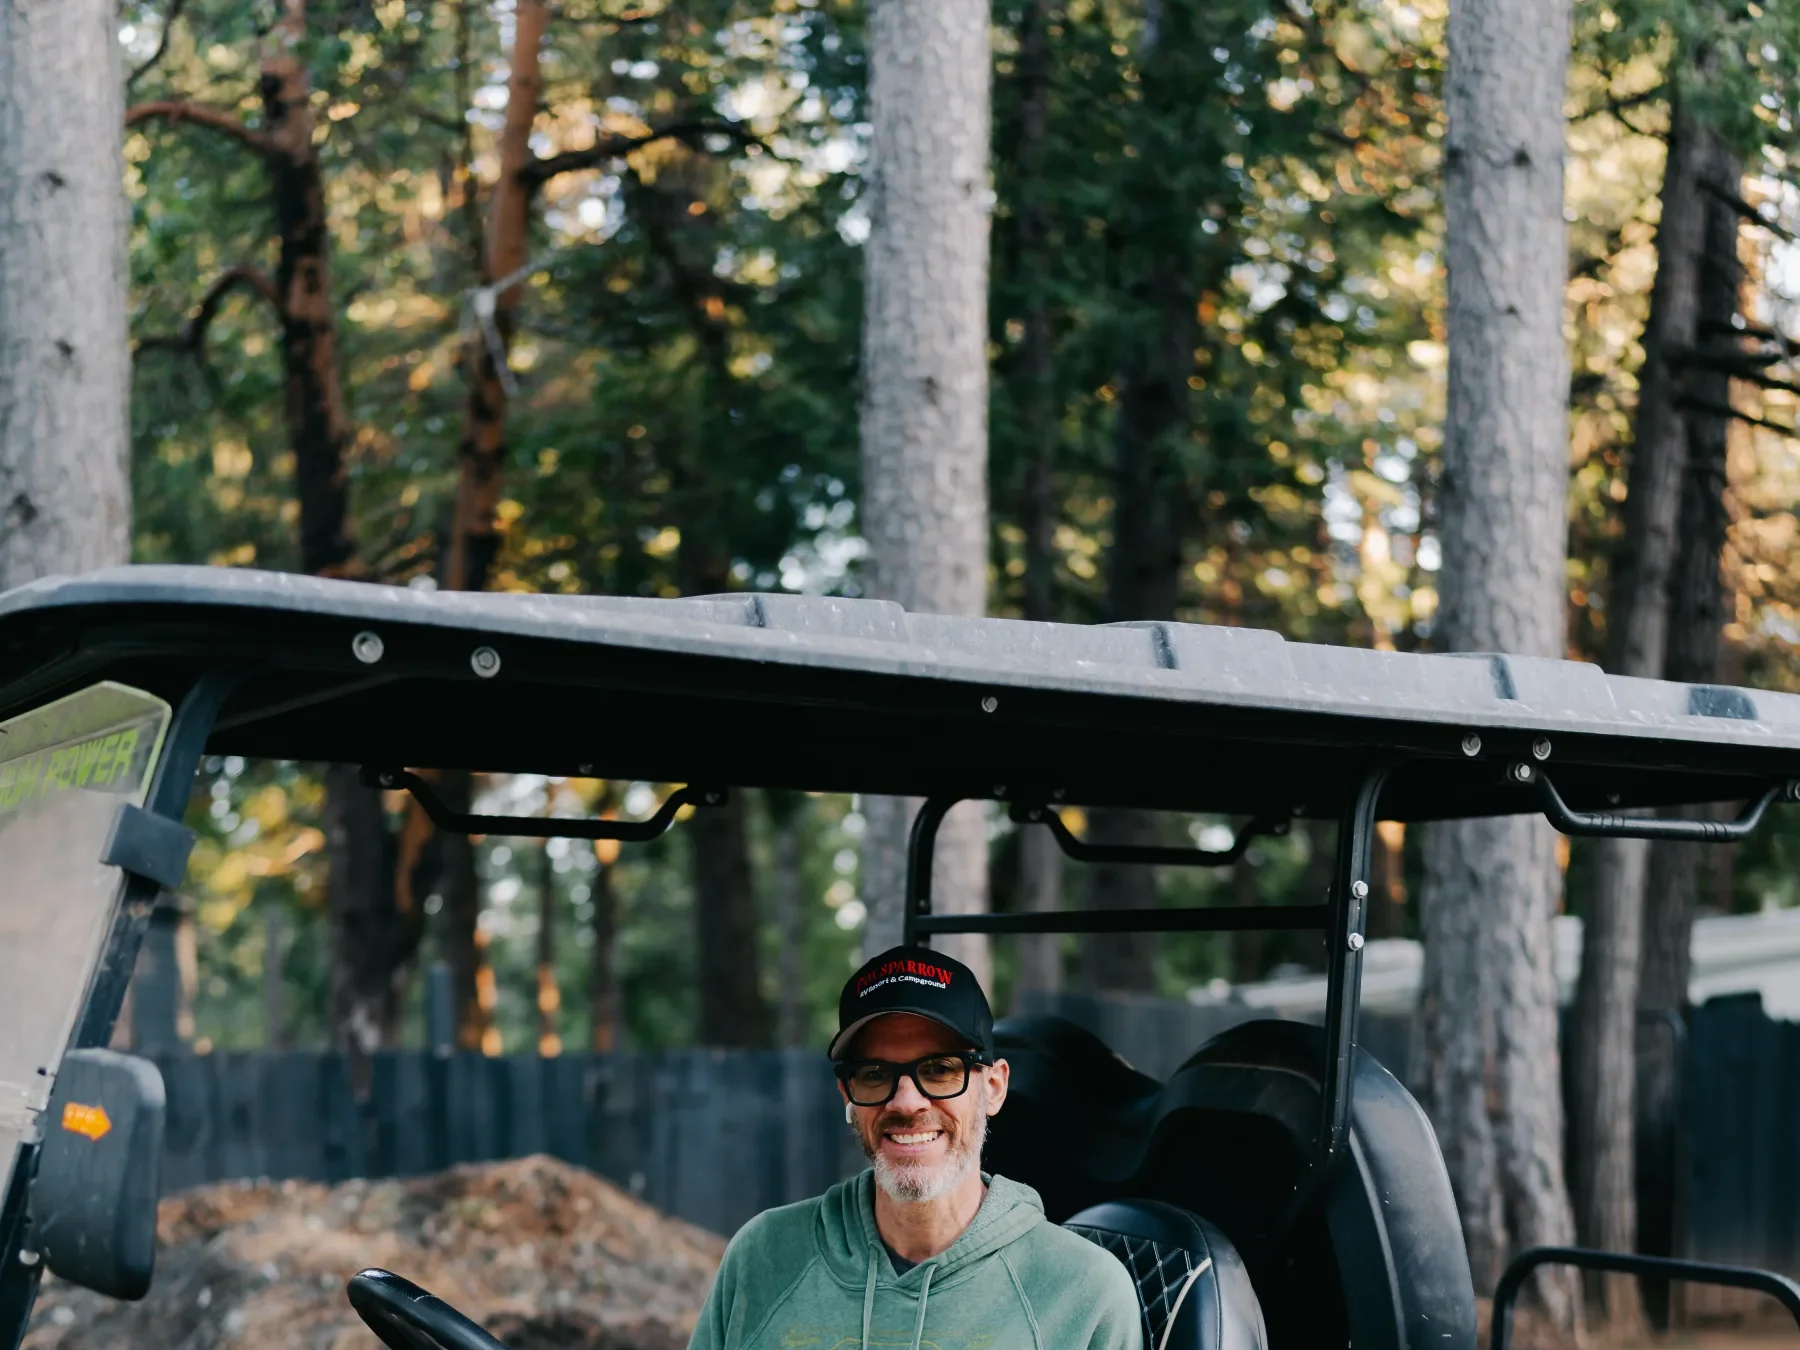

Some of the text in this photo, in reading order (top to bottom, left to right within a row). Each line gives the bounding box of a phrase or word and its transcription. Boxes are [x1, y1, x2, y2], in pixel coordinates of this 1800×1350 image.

[41, 729, 138, 798] POWER
[880, 959, 953, 985] SPARROW
[859, 975, 946, 998] RV Resort & Campground
